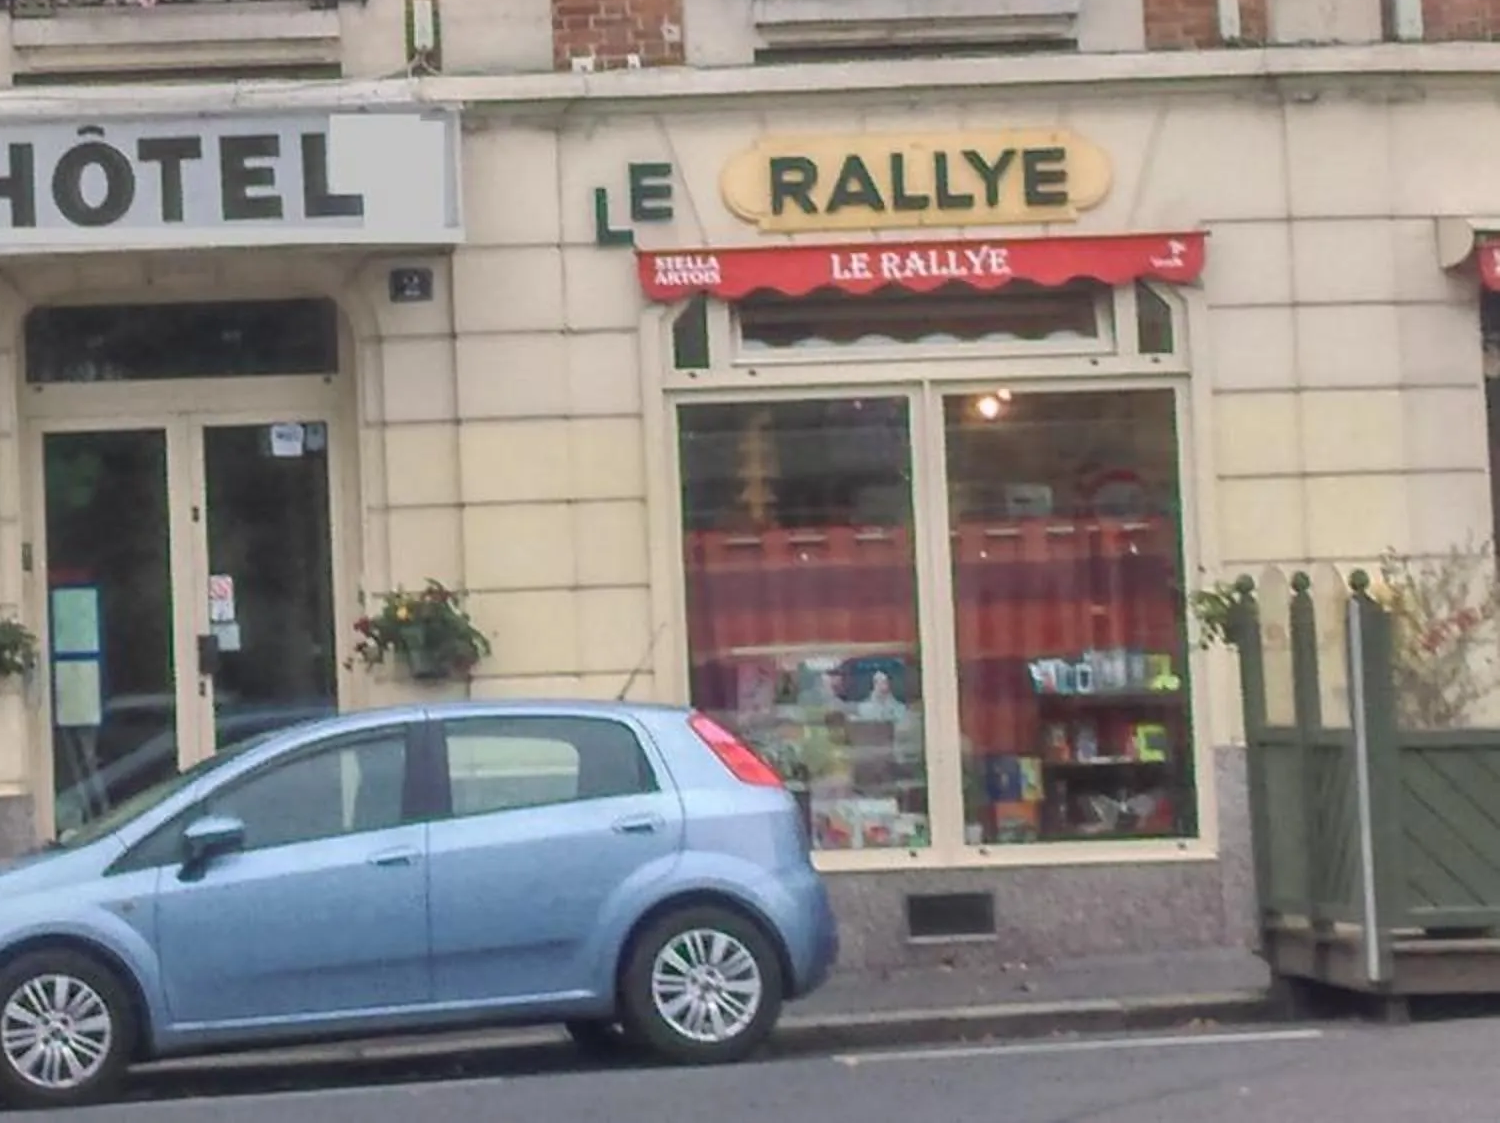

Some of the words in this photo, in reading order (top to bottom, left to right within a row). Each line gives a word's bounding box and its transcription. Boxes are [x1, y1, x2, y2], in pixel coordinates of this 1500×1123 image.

[595, 162, 673, 247] LE
[769, 147, 1068, 215] RALLYE
[830, 253, 872, 279] LE
[880, 245, 1012, 279] RALLYE
